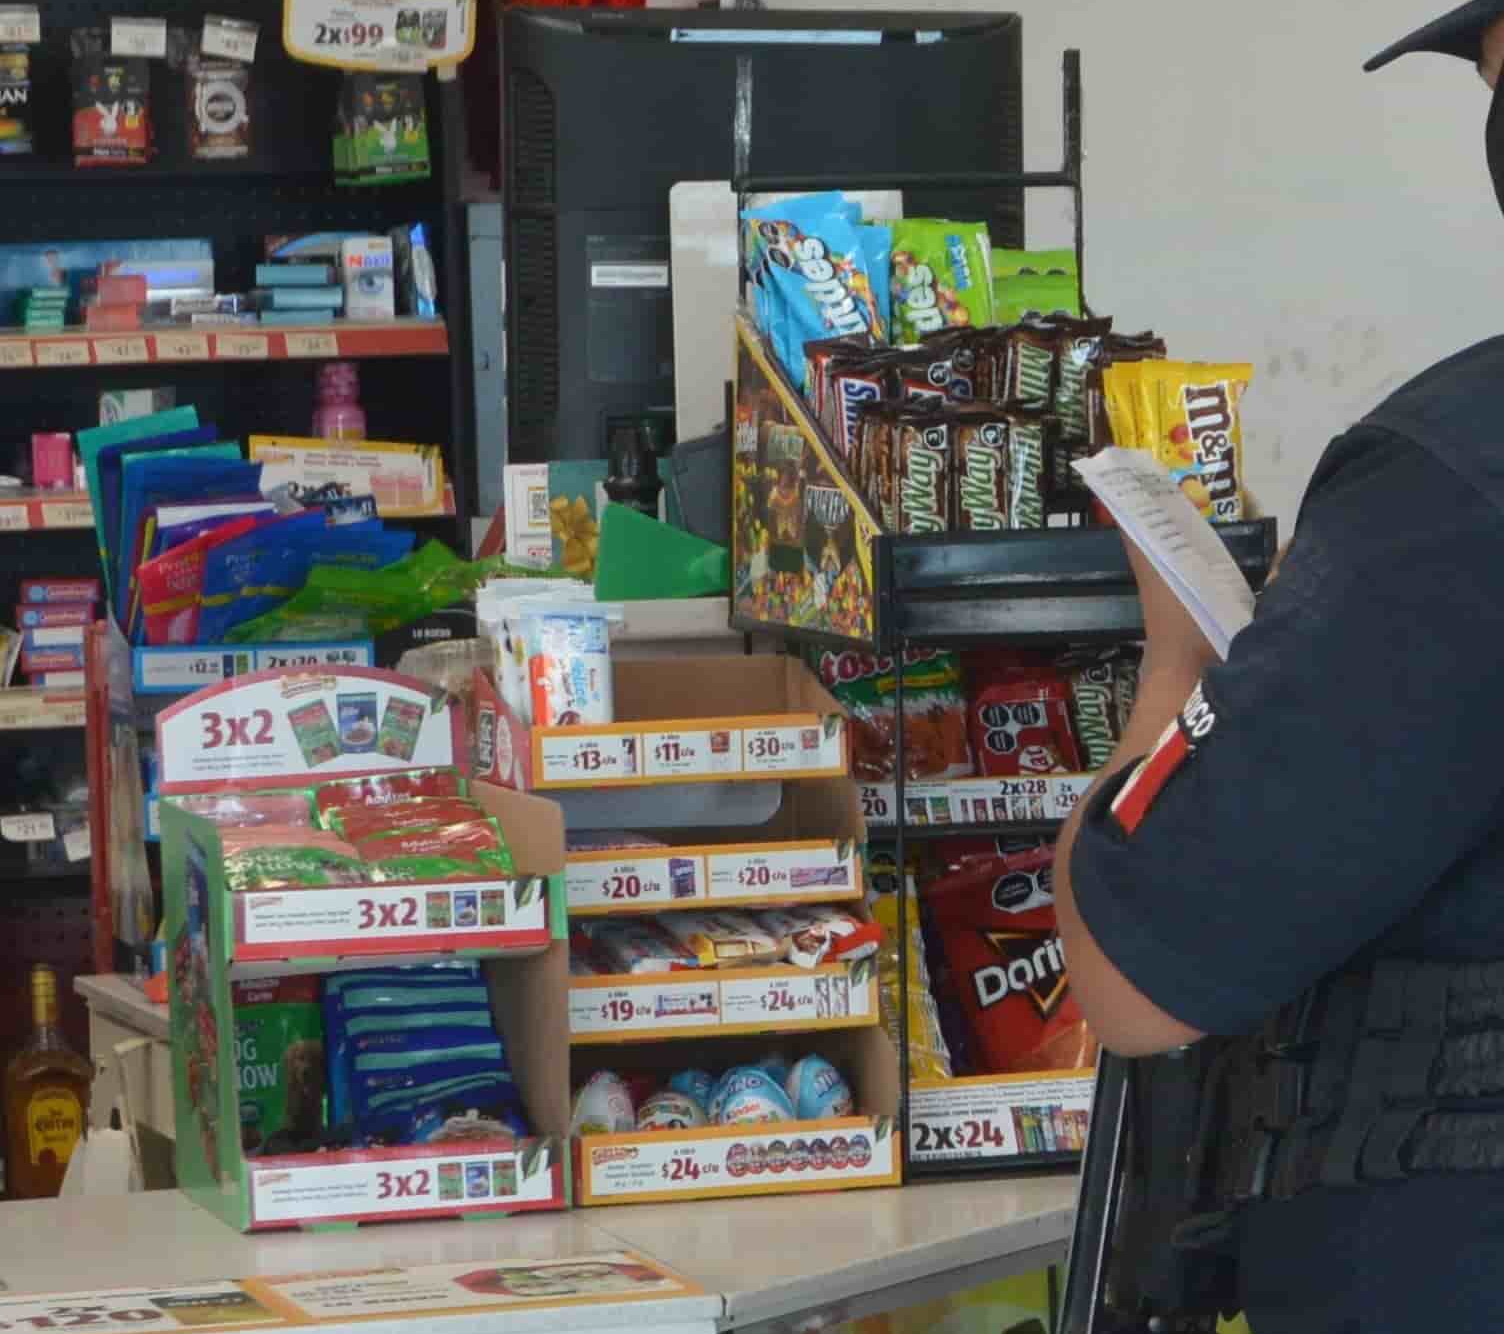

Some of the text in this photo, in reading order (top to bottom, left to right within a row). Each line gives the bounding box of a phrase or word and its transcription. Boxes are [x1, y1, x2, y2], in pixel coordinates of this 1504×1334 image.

[200, 708, 276, 749] 3x2
[748, 736, 780, 757] $30
[573, 750, 602, 771] $13
[602, 875, 641, 899] $20
[738, 866, 770, 886] $20
[357, 898, 418, 929] 3x2
[601, 1000, 634, 1021] $19
[761, 990, 795, 1011] $24
[911, 1119, 1005, 1152] 2x$24
[661, 1158, 701, 1180] $24
[376, 1171, 432, 1200] 3x2
